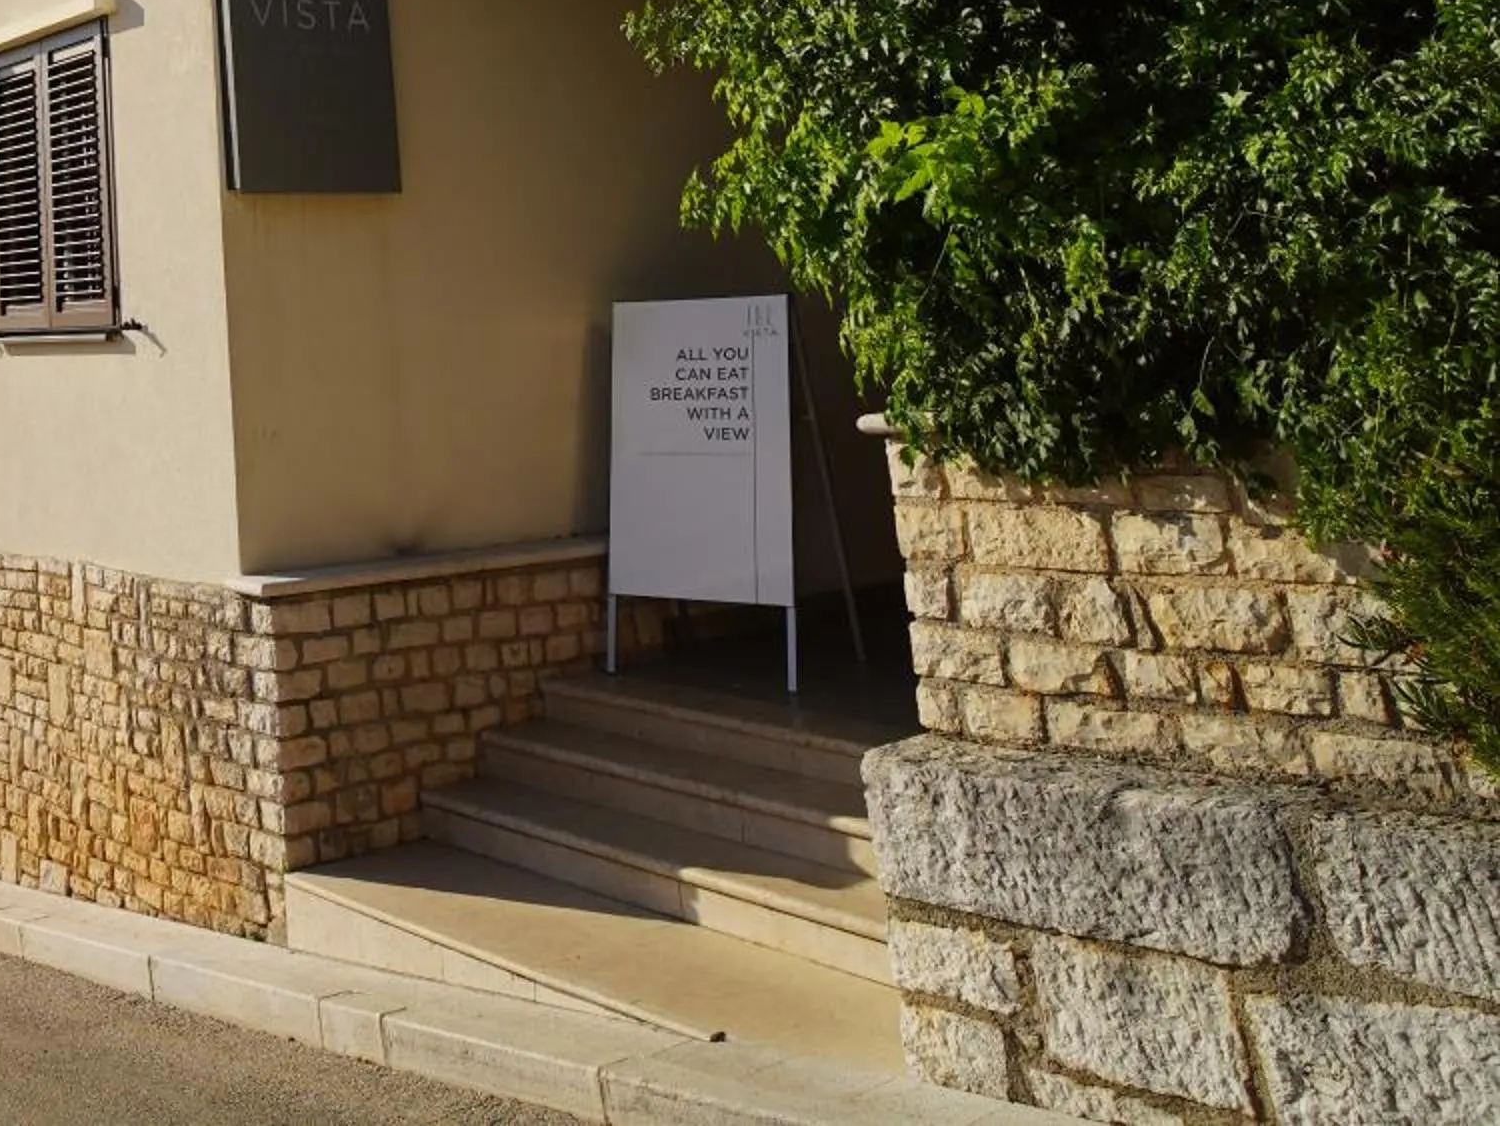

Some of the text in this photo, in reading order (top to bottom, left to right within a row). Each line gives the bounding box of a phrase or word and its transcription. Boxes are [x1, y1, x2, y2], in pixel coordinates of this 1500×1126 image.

[676, 347, 749, 361] ALL YOU
[675, 367, 749, 381] CAN EAT
[650, 387, 749, 401] BREAKFAST
[687, 406, 749, 421] WITH A
[704, 427, 750, 441] VIEW
